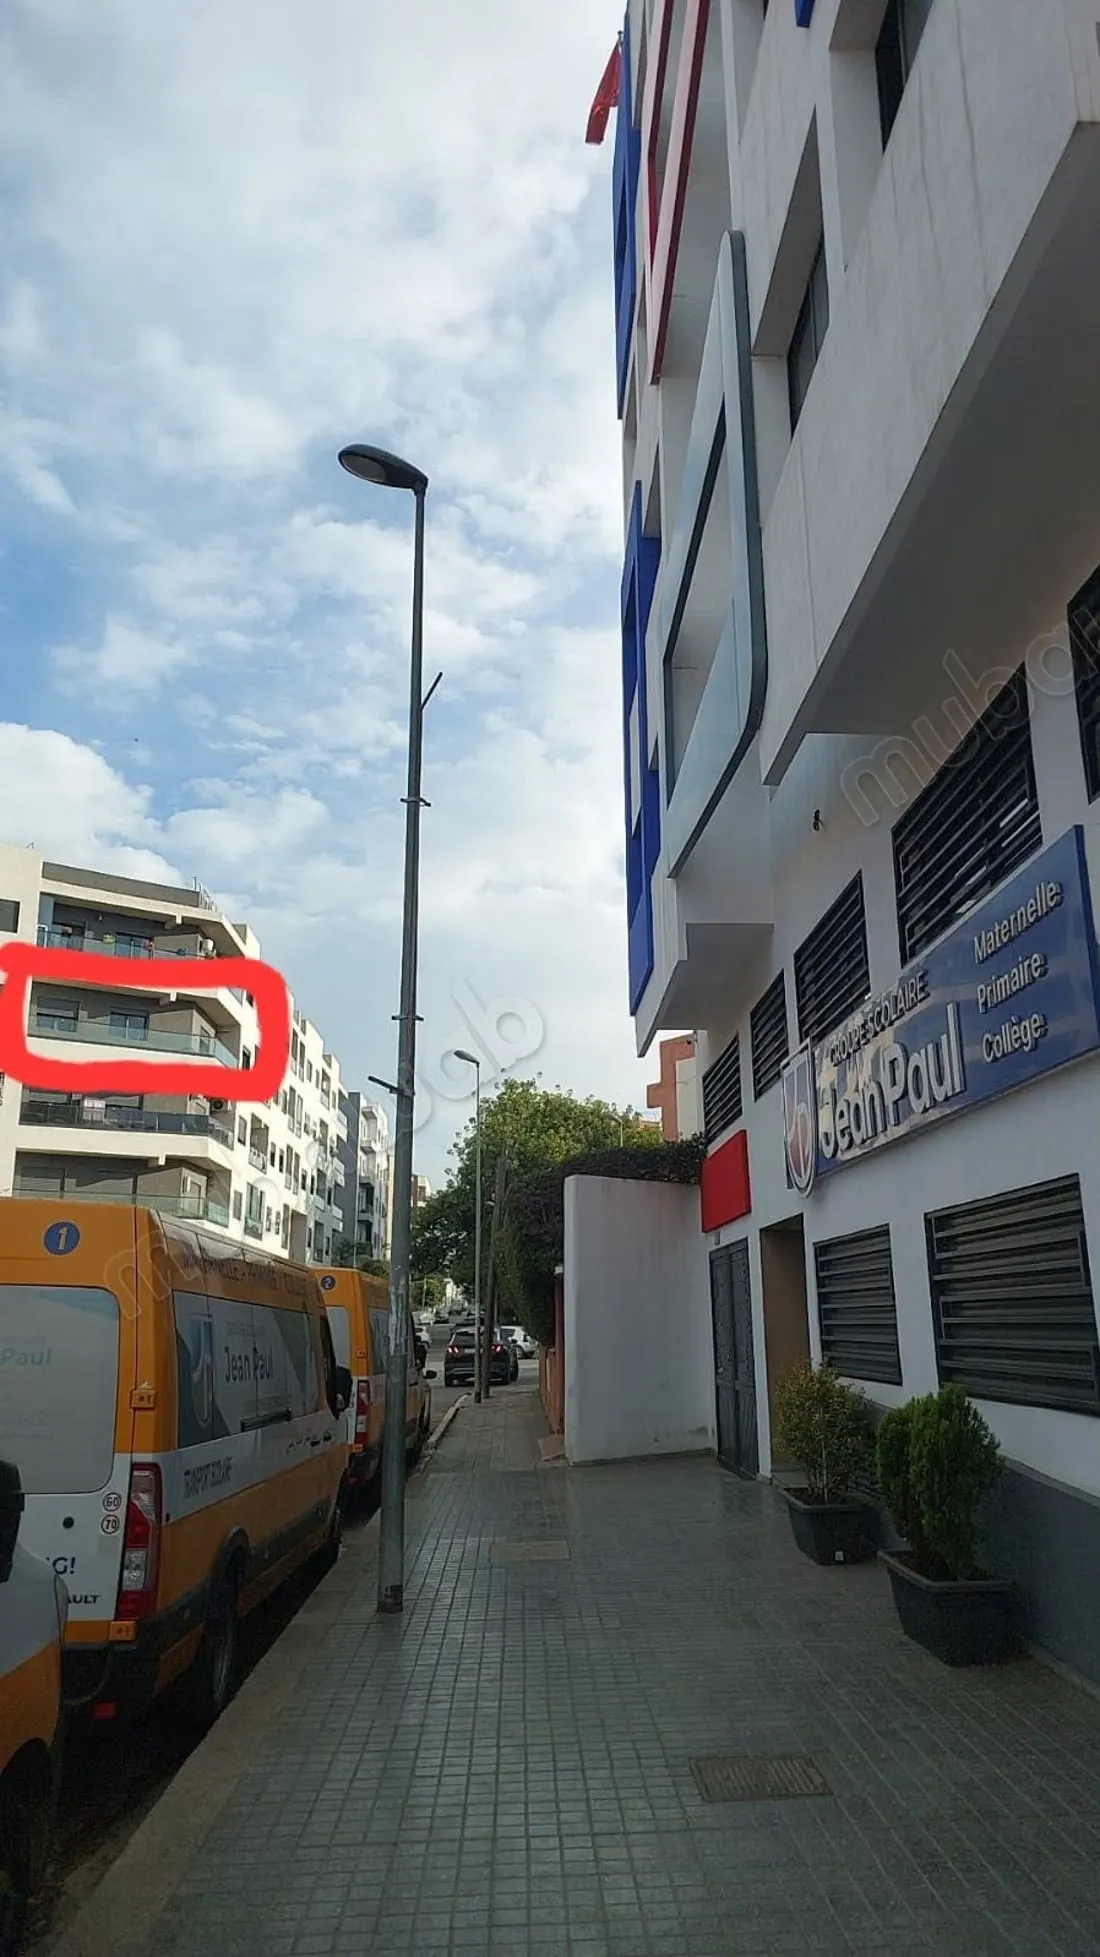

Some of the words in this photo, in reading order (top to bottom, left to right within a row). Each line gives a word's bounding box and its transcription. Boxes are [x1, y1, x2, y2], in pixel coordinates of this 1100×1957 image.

[974, 881, 1061, 963] Maternelle
[976, 953, 1044, 1014] Primaire
[830, 1021, 870, 1067] GROUPE
[867, 970, 929, 1039] SCOLAIRE
[982, 1013, 1043, 1064] Collège
[819, 1076, 888, 1159] Jean
[880, 1002, 964, 1127] Paul
[58, 1226, 68, 1250] 1
[1, 1347, 53, 1366] Paul
[224, 1346, 251, 1382] Jean
[252, 1346, 274, 1380] Paul
[106, 1497, 119, 1508] 60
[105, 1518, 118, 1530] 70
[45, 1556, 77, 1575] G!
